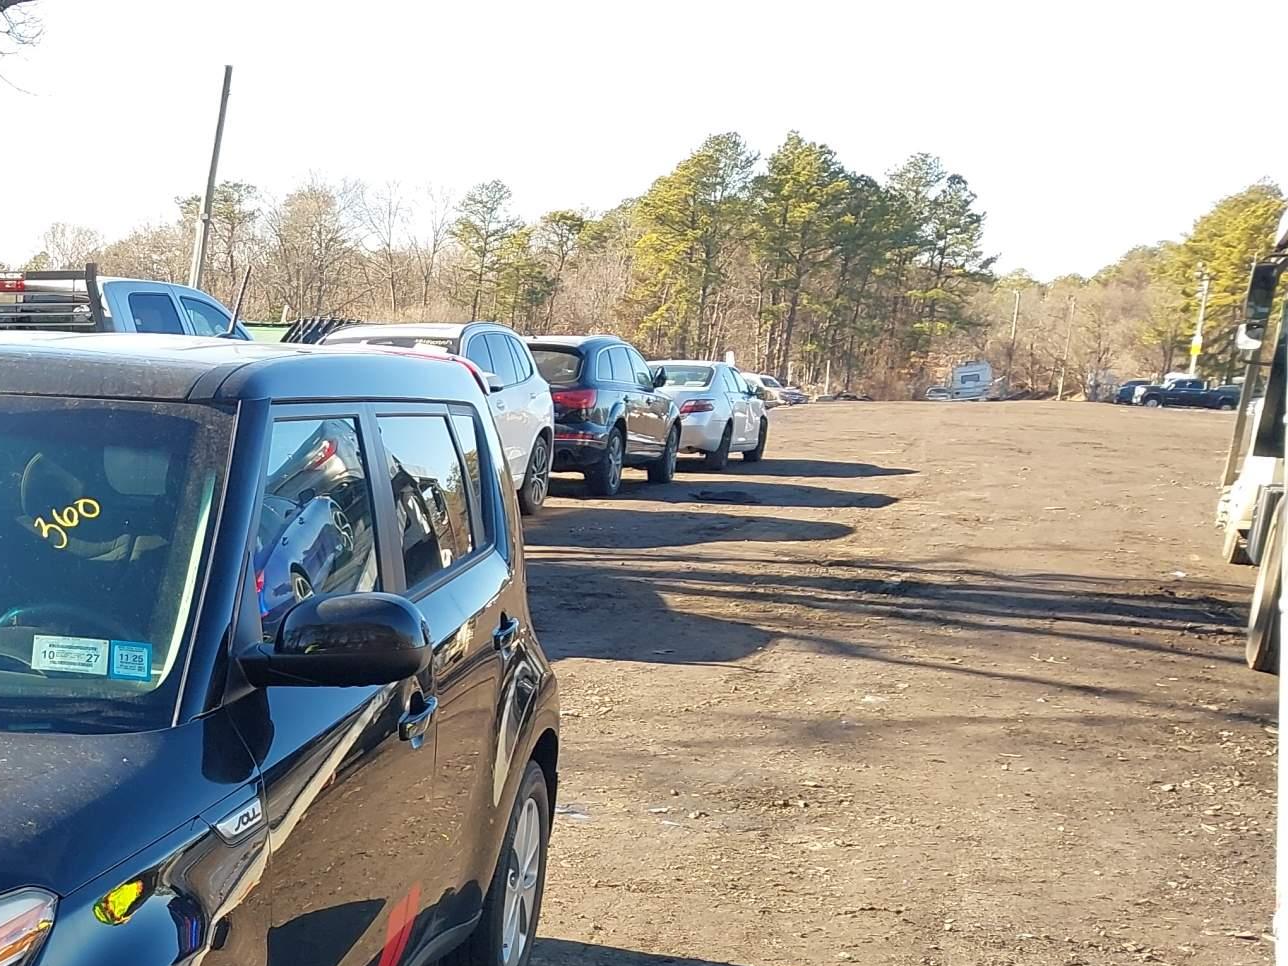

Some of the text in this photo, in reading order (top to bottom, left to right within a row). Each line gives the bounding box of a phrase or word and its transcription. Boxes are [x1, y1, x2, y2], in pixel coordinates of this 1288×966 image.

[33, 497, 101, 550] 360
[41, 649, 56, 660] 10
[85, 653, 101, 664] 27
